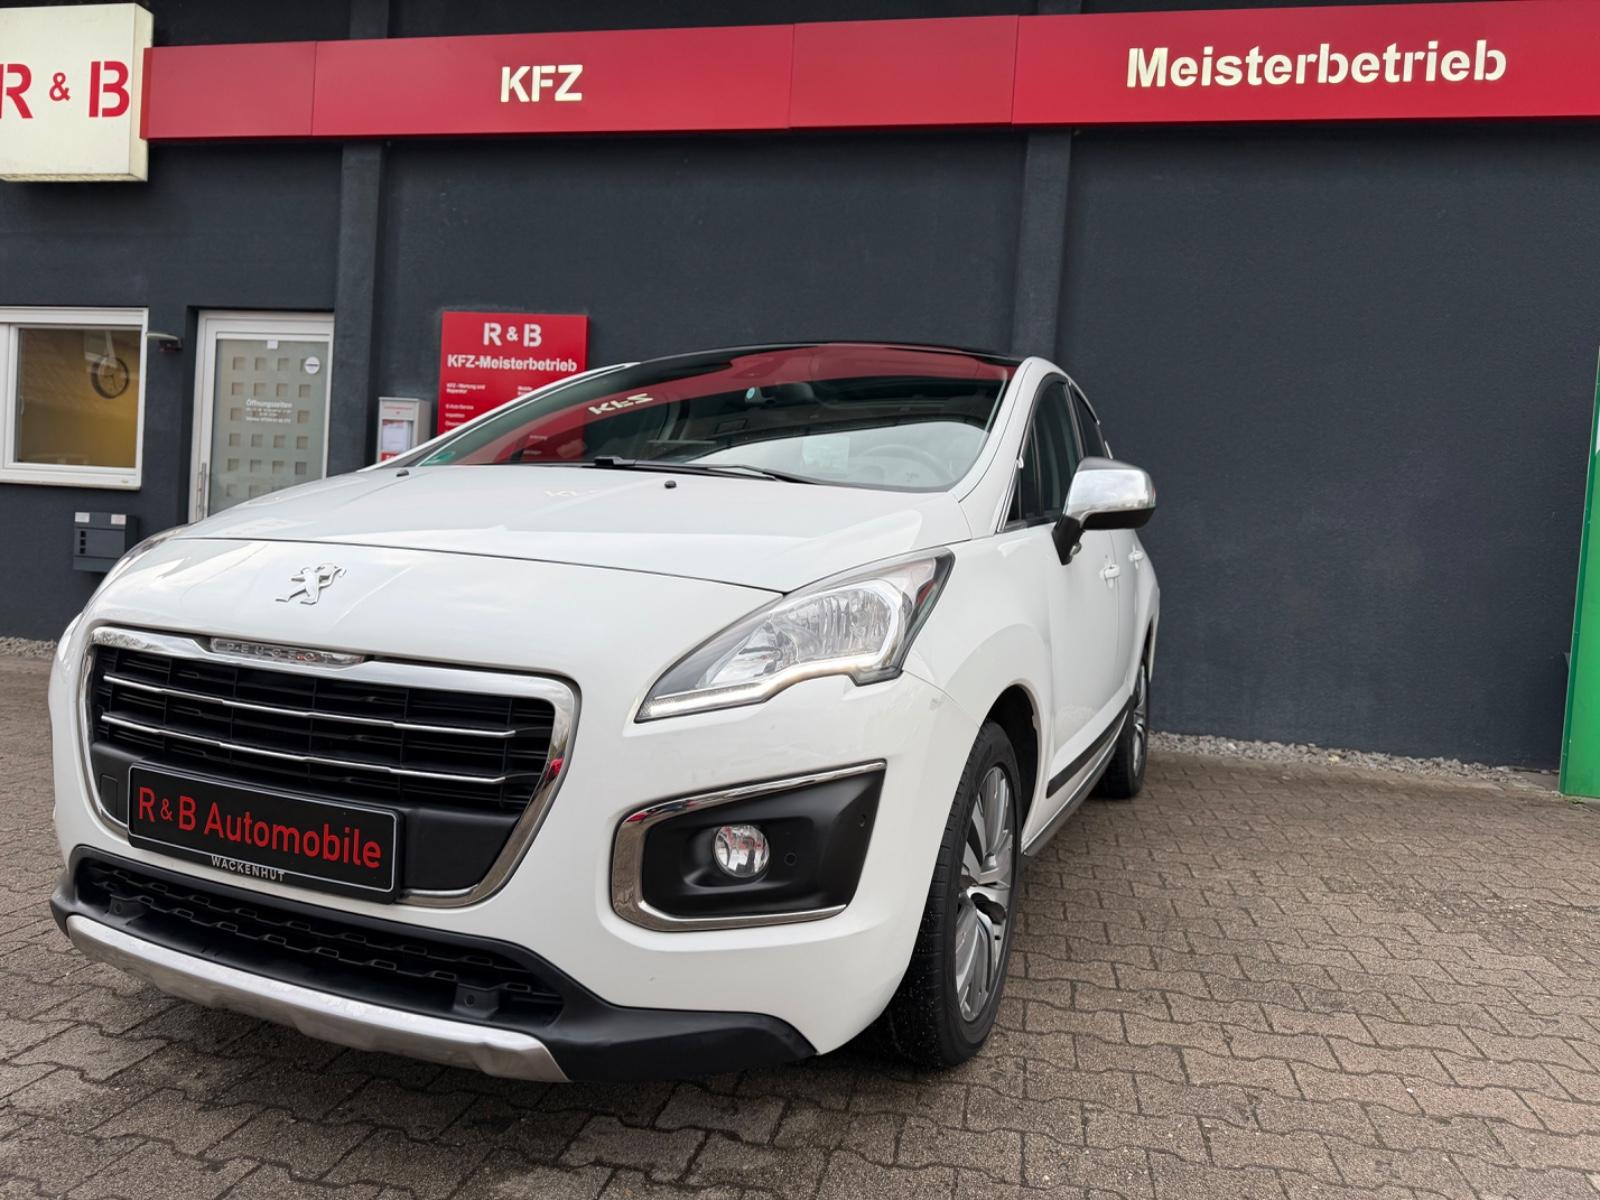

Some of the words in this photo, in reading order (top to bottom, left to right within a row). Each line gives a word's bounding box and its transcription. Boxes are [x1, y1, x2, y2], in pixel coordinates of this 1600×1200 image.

[1126, 39, 1507, 88] Meisterbetrieb
[0, 63, 33, 119] R
[49, 72, 71, 101] &
[88, 61, 130, 117] B
[500, 64, 584, 103] KFZ
[483, 322, 502, 346] R
[506, 326, 519, 342] &
[523, 323, 542, 347] B
[447, 354, 577, 372] KFZ-Meisterbetrieb
[226, 643, 335, 664] PEUGEOT
[138, 787, 155, 822] R
[160, 798, 173, 821] &
[178, 795, 197, 831] B
[203, 802, 382, 868] Automobile
[211, 854, 286, 883] WACKENHUT
